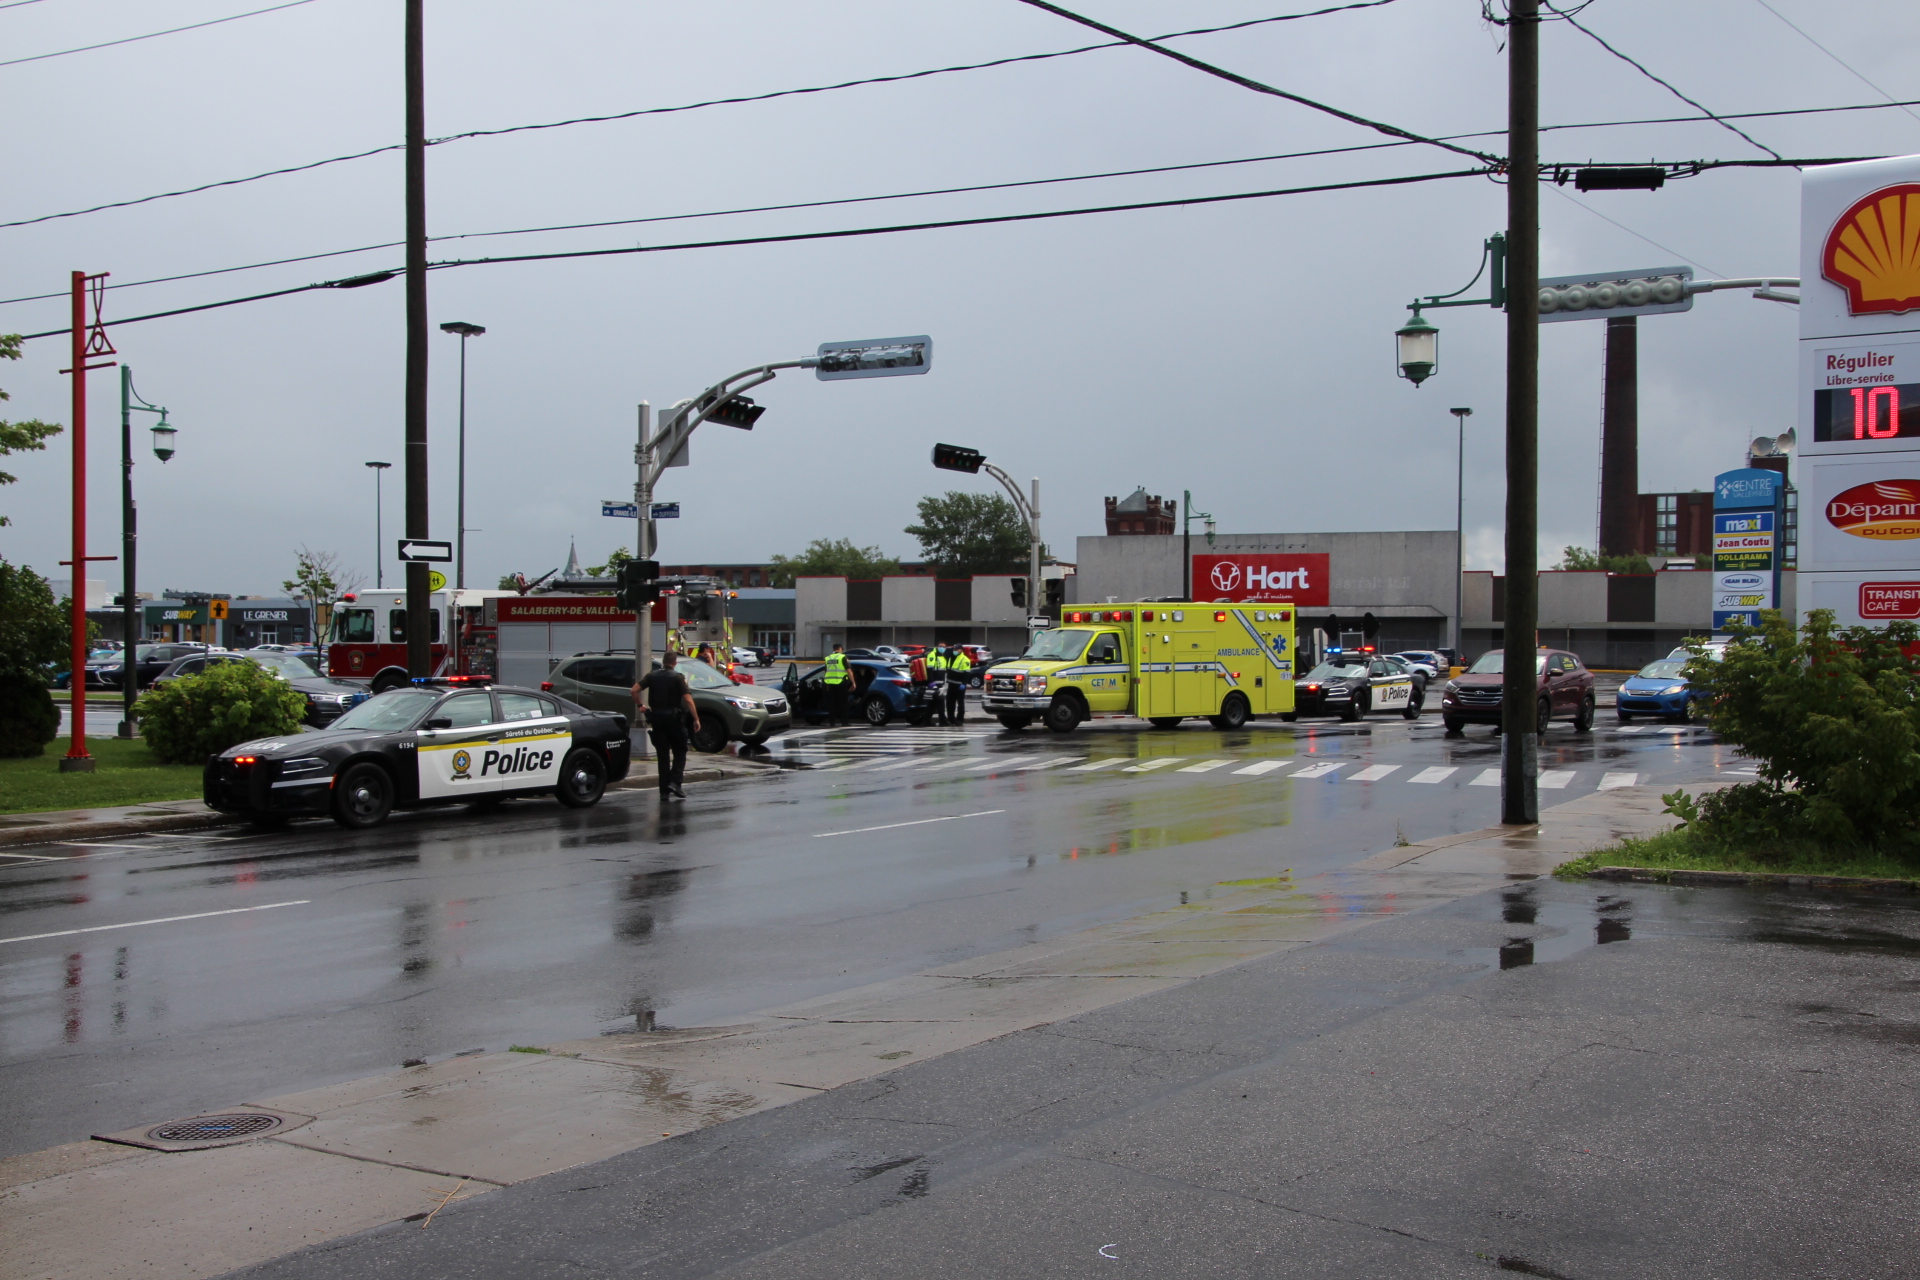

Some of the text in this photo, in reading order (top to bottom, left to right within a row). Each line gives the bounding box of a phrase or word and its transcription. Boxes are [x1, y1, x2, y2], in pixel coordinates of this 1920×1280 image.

[1827, 351, 1894, 372] Régulier
[1827, 373, 1894, 386] Libre-service
[1850, 386, 1898, 439] 10
[1731, 478, 1772, 492] CENTRE
[1732, 489, 1772, 498] VALLEYFIELD
[1725, 514, 1762, 531] maxi
[1717, 538, 1769, 548] Jean Coutu
[1718, 553, 1768, 561] DOLLARAMA
[1246, 565, 1310, 590] Hart
[1720, 593, 1765, 607] SUBWAY
[1867, 599, 1899, 611] CAFÉ
[162, 609, 197, 620] SUBWAY
[243, 611, 253, 620] LE
[1217, 648, 1260, 657] AMBULANCE
[1388, 686, 1408, 700] Police
[481, 747, 553, 776] Police
